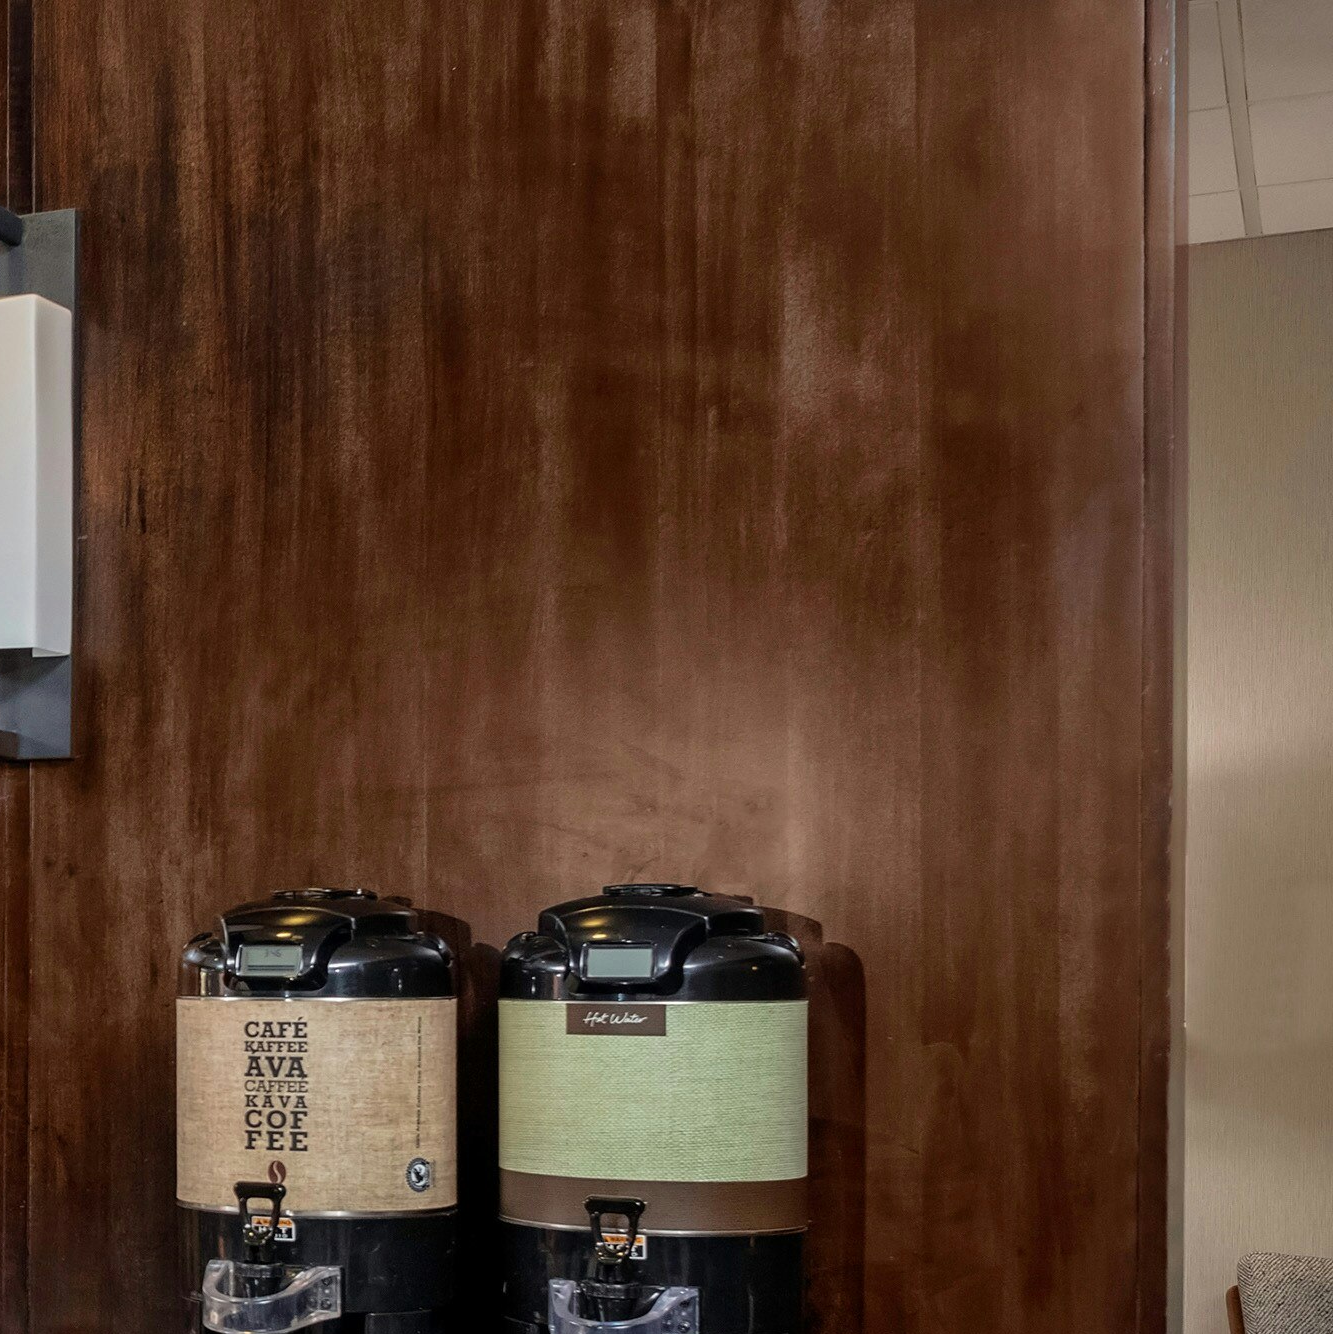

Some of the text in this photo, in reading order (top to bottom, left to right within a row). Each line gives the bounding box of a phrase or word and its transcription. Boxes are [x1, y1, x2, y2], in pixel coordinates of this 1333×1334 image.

[244, 1016, 308, 1038] CAFÉ
[582, 1011, 648, 1027] Hot Water
[244, 1040, 308, 1053] KAFFEE
[244, 1109, 308, 1129] COF
[244, 1130, 309, 1152] FEE
